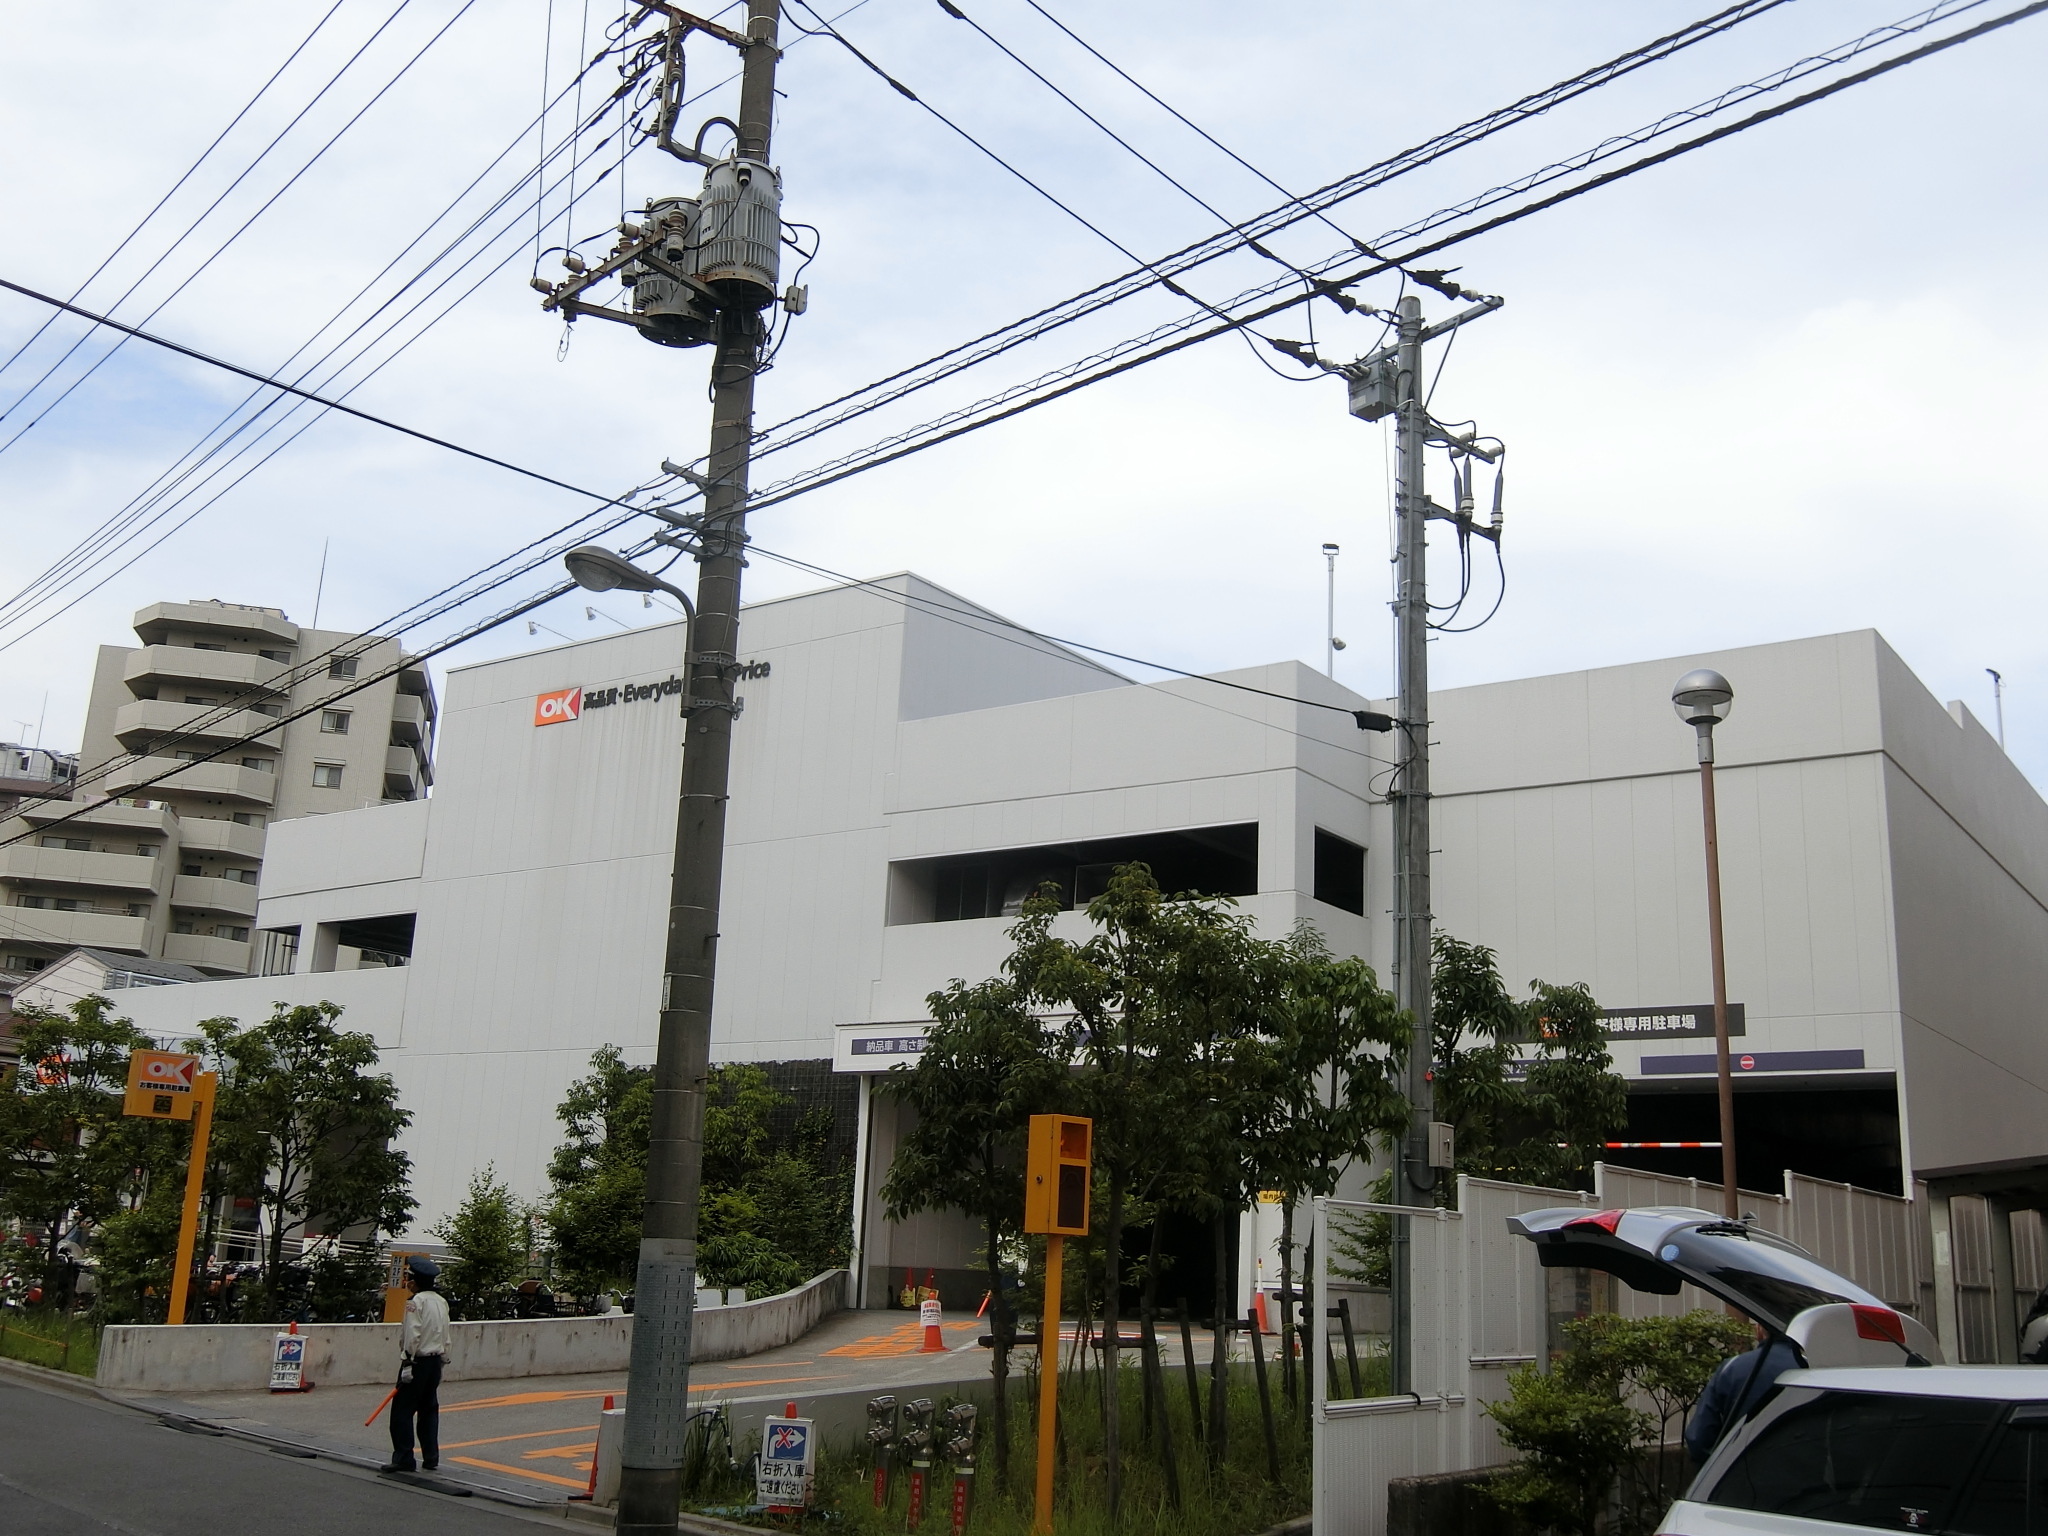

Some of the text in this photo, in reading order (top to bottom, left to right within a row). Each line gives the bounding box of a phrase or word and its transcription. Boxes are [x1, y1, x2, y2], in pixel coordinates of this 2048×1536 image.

[540, 688, 581, 719] OK
[866, 1040, 894, 1053] 納品車
[147, 1058, 195, 1086] OK
[391, 1267, 401, 1276] 2F
[391, 1279, 400, 1287] 1F
[762, 1461, 806, 1479] 右折入庫
[760, 1479, 804, 1495] ご遠慮ください
